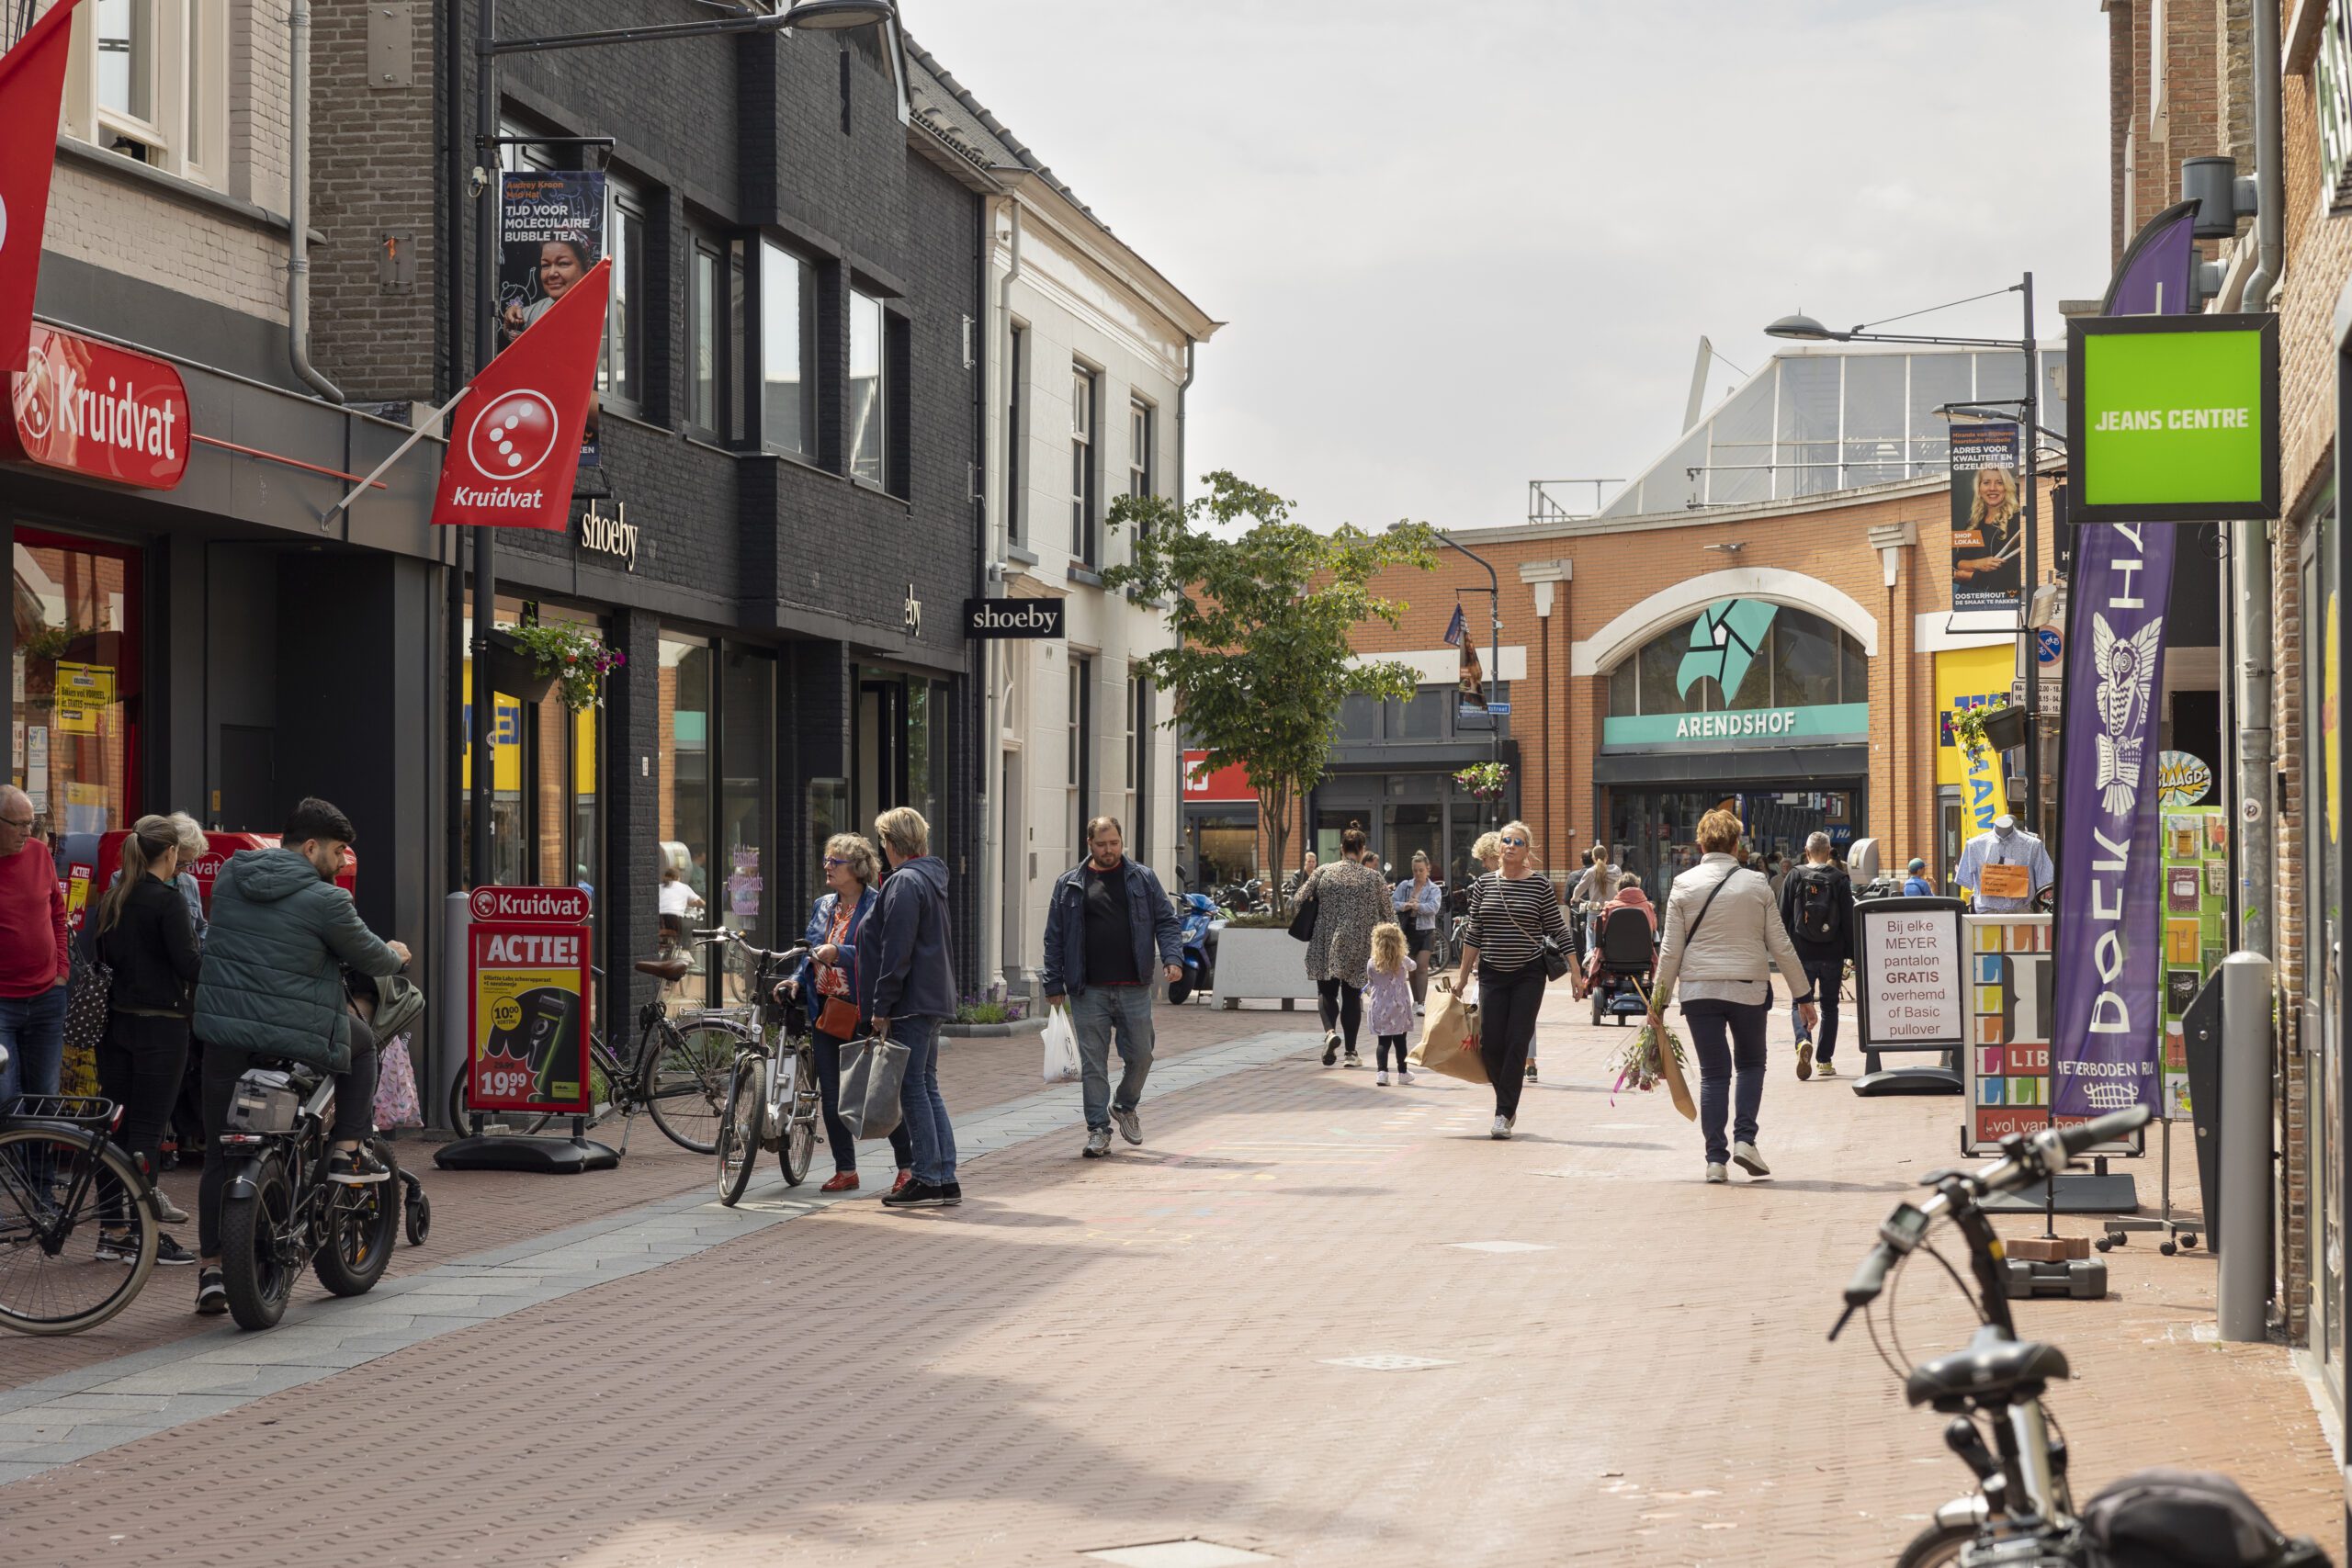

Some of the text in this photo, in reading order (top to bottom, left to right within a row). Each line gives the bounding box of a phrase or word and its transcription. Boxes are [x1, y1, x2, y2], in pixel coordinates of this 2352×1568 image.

[507, 181, 537, 189] Audrey
[505, 205, 568, 216] TIJD VOOR
[504, 218, 591, 229] MOLECULAIRE
[504, 231, 578, 242] BUBBLE TEA
[58, 364, 175, 460] Kruidvat
[2095, 407, 2249, 431] JEANS CENTRE
[1952, 445, 2007, 454] ADRES VOOR
[1952, 453, 2013, 462] KWALITEIT EN
[1952, 461, 2015, 470] GEZELLIGHEID
[452, 486, 544, 509] Kruidvat
[582, 498, 639, 572] shoeby
[1954, 592, 2007, 600] OOSTERHOUT
[973, 604, 1058, 634] shoeby
[68, 698, 83, 709] GRATIS
[1676, 711, 1795, 738] ARENDSHOF
[72, 866, 91, 878] ACTIE!
[499, 894, 582, 916] Kruidvat
[1887, 919, 1934, 934] Bij elke
[486, 934, 579, 964] ACTIE!
[1885, 937, 1937, 950] MEYER
[1884, 954, 1939, 969] pantalon
[1886, 971, 1939, 984] GRATIS
[1881, 988, 1946, 1001] overhemd
[1888, 1006, 1940, 1018] of Basic
[1889, 1024, 1940, 1038] pullover
[481, 1071, 527, 1097] 19.99
[1993, 1117, 2015, 1133] vol
[2021, 1121, 2049, 1133] van
